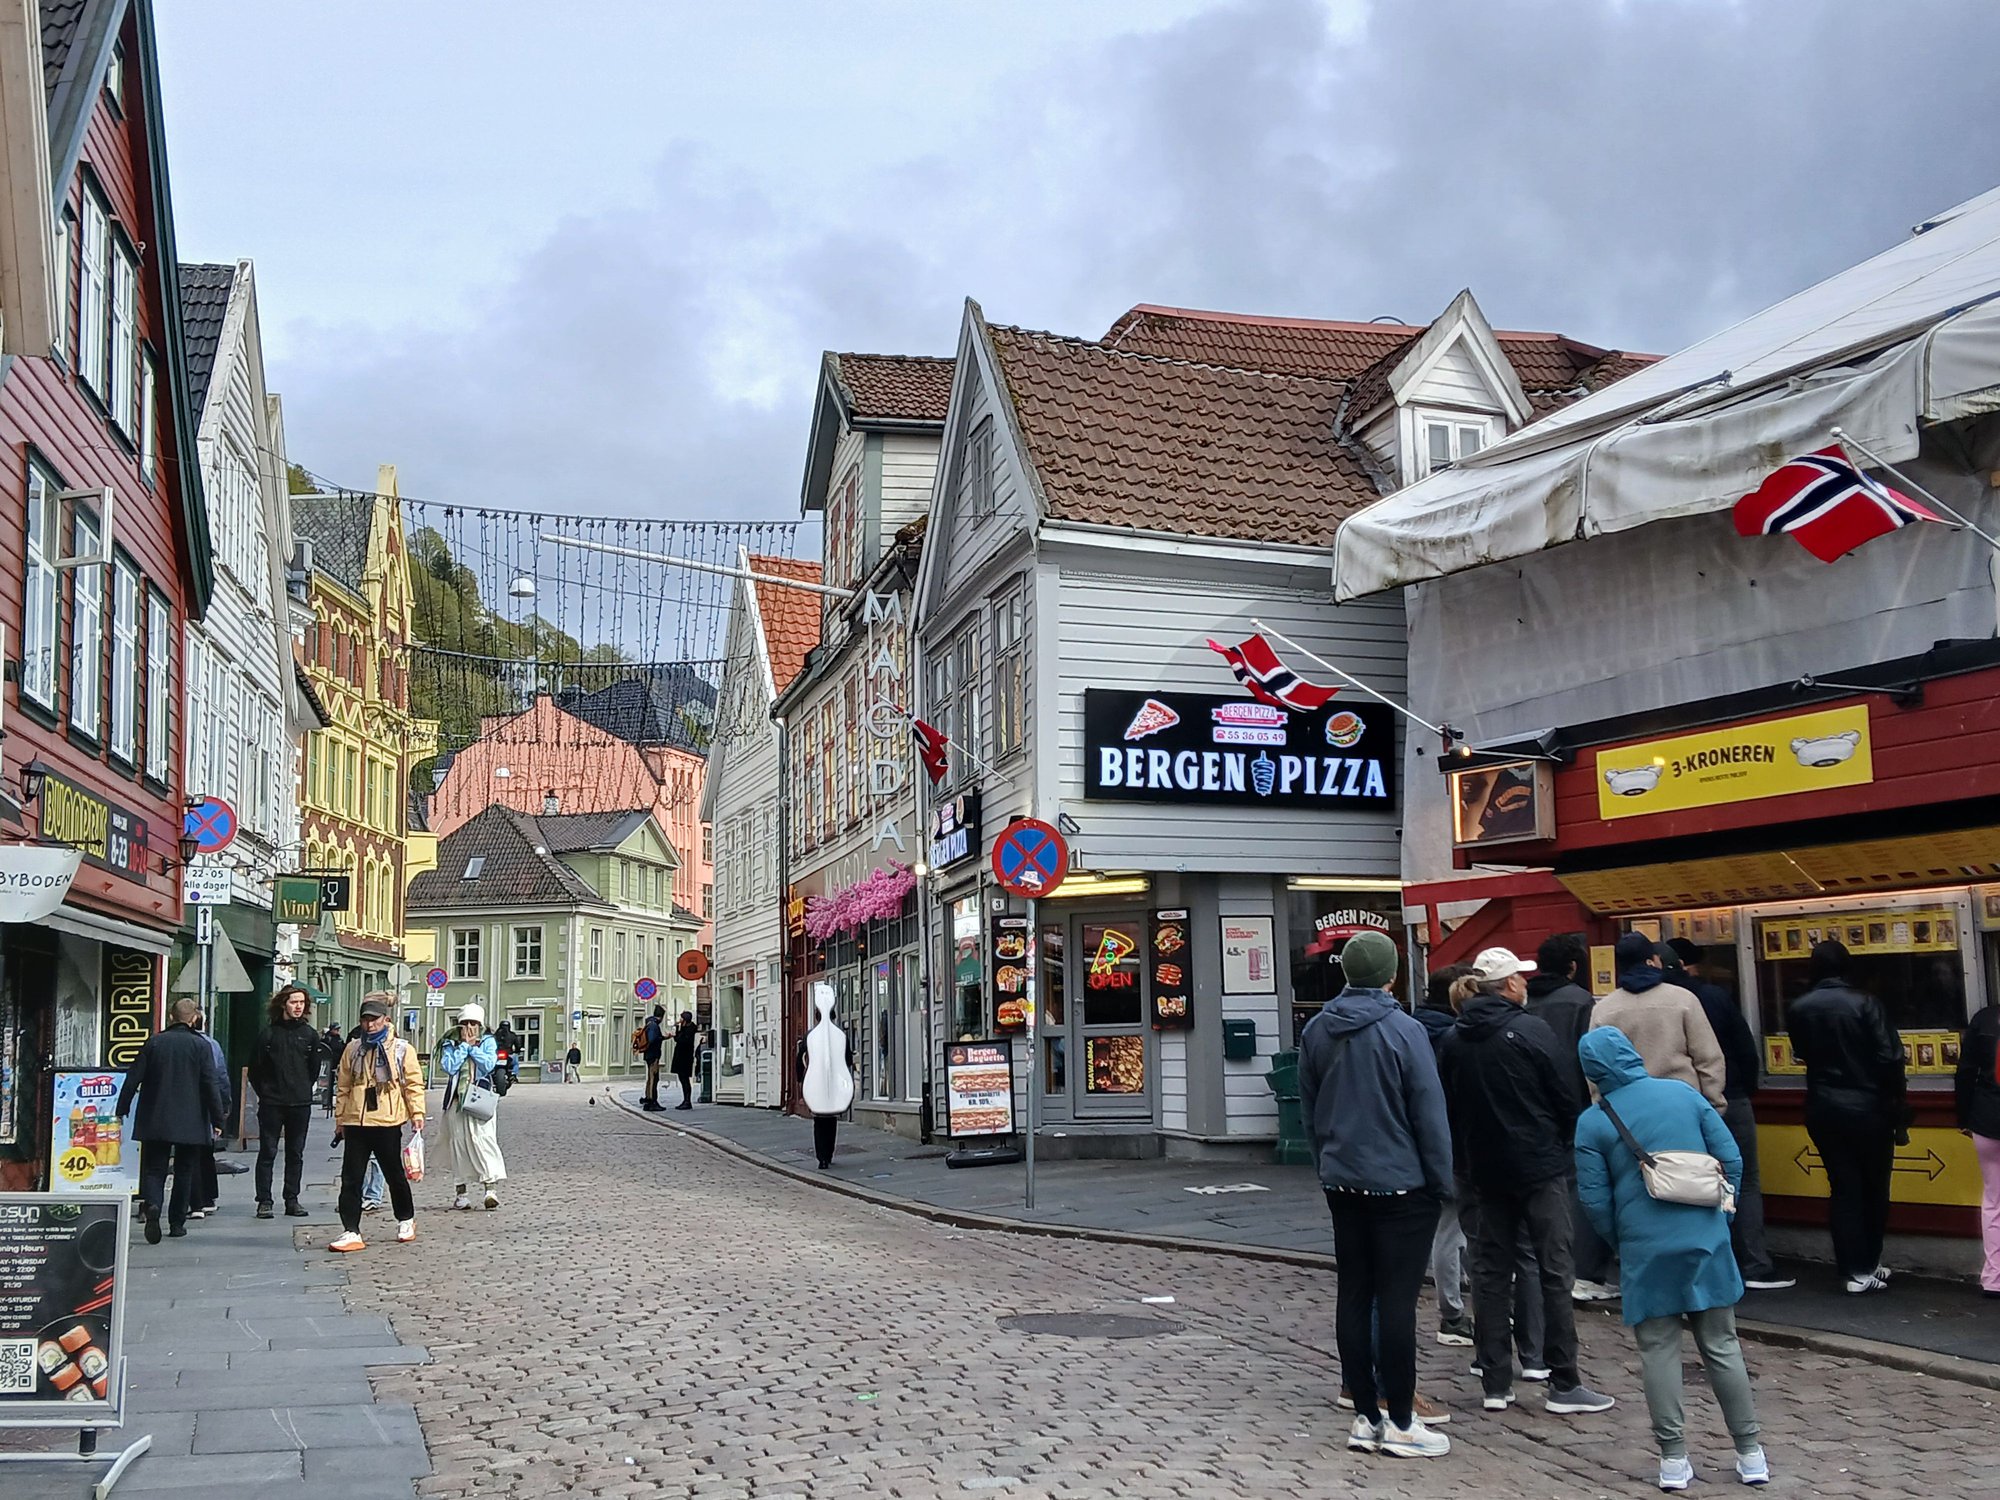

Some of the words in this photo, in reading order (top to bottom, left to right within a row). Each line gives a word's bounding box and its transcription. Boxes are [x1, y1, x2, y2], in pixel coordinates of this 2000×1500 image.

[1224, 706, 1253, 717] BERGEN
[1254, 707, 1276, 718] PIZZA
[863, 588, 906, 853] MAGDA
[1227, 731, 1240, 740] 55
[1242, 732, 1255, 740] 36
[1272, 733, 1284, 742] 49
[1672, 744, 1776, 777] 3-KRONEREN
[1099, 746, 1247, 792] BERGEN
[1279, 754, 1387, 797] PIZZA
[184, 880, 201, 889] Alle
[205, 881, 229, 891] dager
[282, 898, 318, 920] Vinyl
[995, 900, 1002, 908] 3
[1315, 909, 1357, 931] BERGEN
[1359, 909, 1389, 930] PIZZA
[1091, 972, 1133, 989] OPEN
[967, 1047, 997, 1056] Bergen
[967, 1055, 1005, 1064] Baguette
[81, 1085, 113, 1097] BILLIG!
[21, 1245, 45, 1253] Hours
